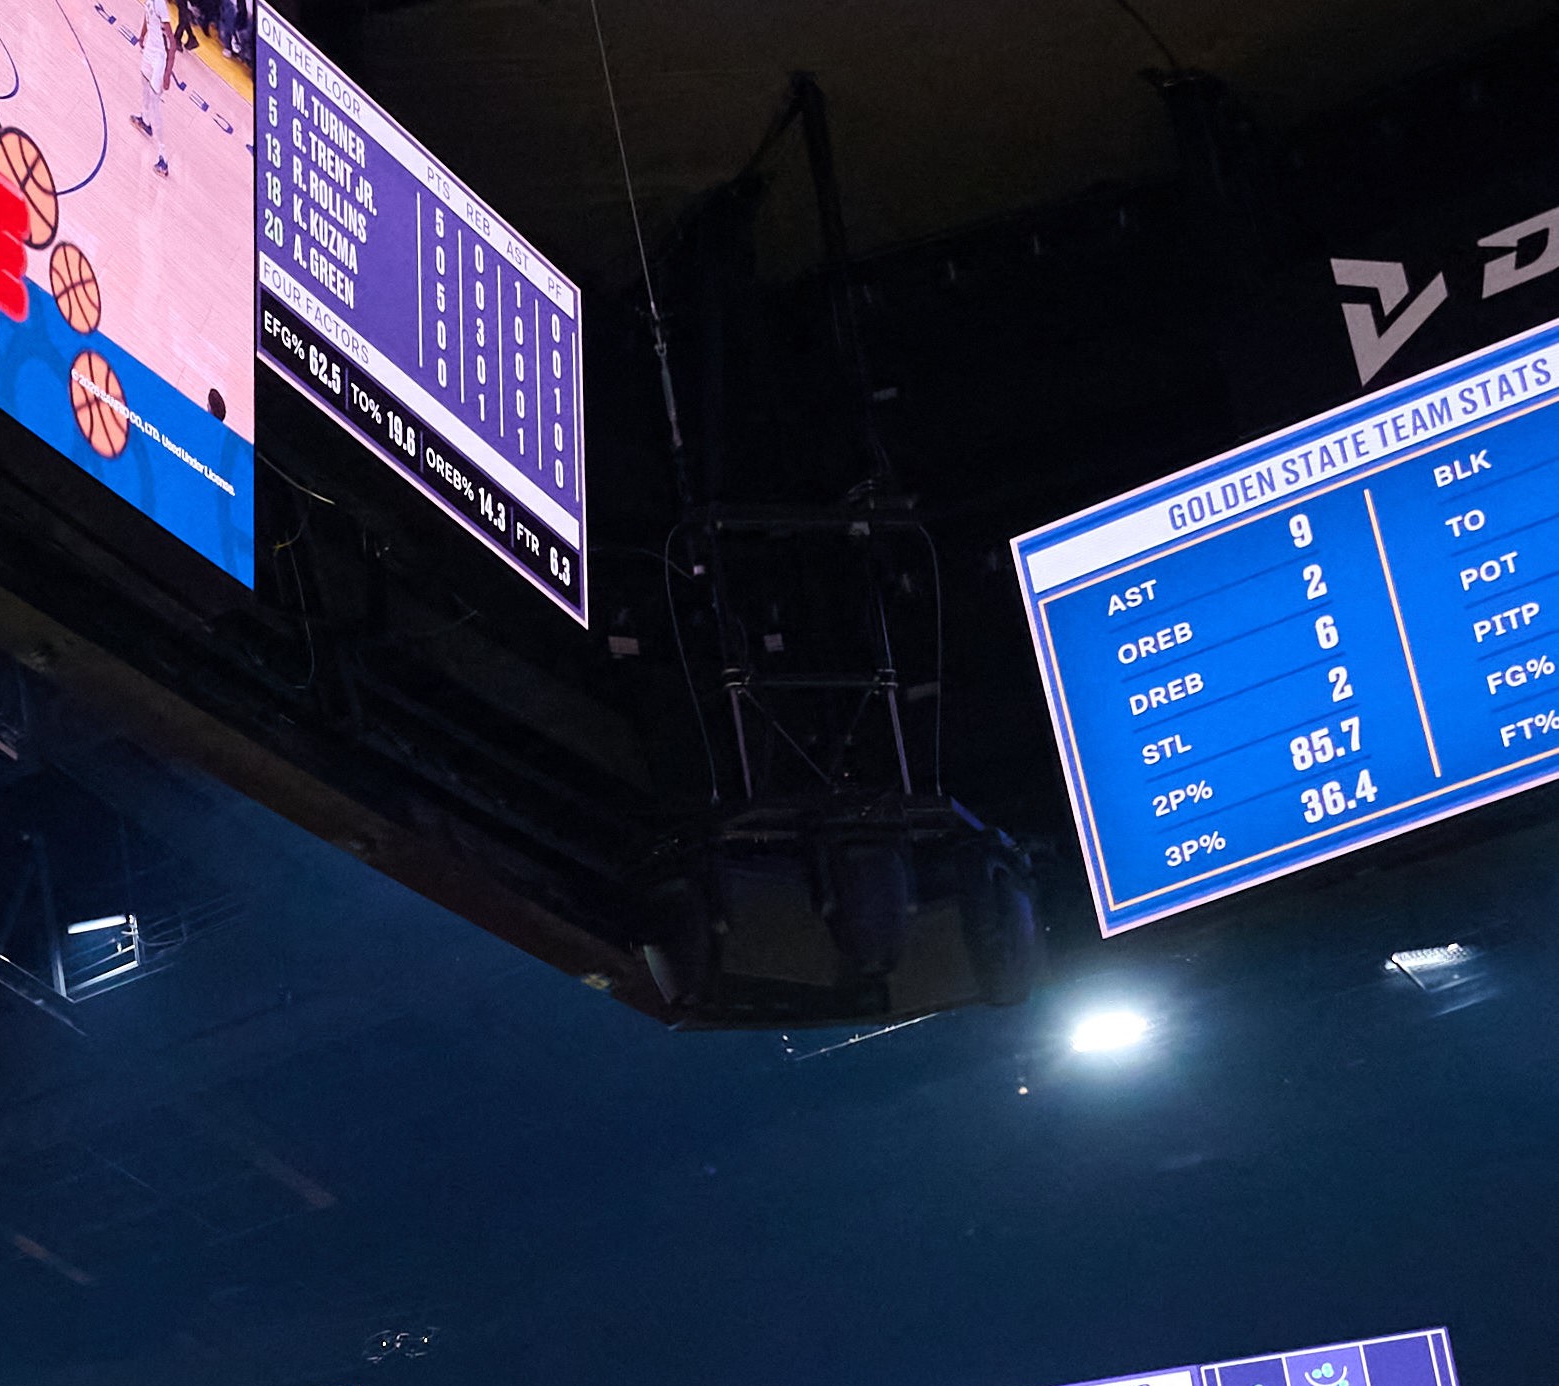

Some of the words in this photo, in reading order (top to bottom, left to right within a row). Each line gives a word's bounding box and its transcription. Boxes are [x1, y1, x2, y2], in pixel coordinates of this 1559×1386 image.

[261, 17, 282, 47] ON
[285, 36, 311, 75] THE
[316, 63, 361, 117] FLOOR
[426, 165, 450, 200] PTS
[466, 203, 491, 237] REB
[506, 240, 529, 272] AST
[547, 276, 562, 299] PF
[268, 58, 278, 89] 3
[291, 79, 309, 118] M.
[311, 95, 366, 169] TURNER
[435, 208, 444, 238] 5
[475, 244, 484, 274] 0
[514, 281, 522, 309] 1
[551, 313, 560, 343] 0
[268, 96, 278, 128] 5
[291, 118, 307, 153] G.
[309, 131, 353, 193] TRENT
[355, 177, 378, 216] JR.
[436, 246, 445, 276] 0
[475, 281, 485, 311] 0
[515, 316, 524, 346] 0
[552, 350, 561, 380] 0
[264, 261, 301, 305] FOUR
[305, 295, 369, 365] FACTORS
[264, 208, 284, 248] 20
[293, 234, 307, 270] A.
[309, 248, 354, 309] GREEN
[437, 358, 447, 388] 0
[478, 393, 485, 422] 1
[517, 427, 525, 456] 1
[555, 459, 564, 489] 0
[265, 133, 281, 168] 13
[292, 155, 307, 192] R.
[309, 170, 367, 244] ROLLINS
[436, 283, 446, 313] 5
[476, 318, 485, 348] 3
[515, 352, 524, 382] 0
[554, 388, 562, 415] 1
[266, 171, 282, 207] 18
[293, 194, 307, 232] K.
[310, 207, 358, 275] KUZMA
[437, 320, 446, 350] 0
[477, 355, 486, 385] 0
[516, 389, 525, 419] 0
[554, 423, 563, 452] 0
[264, 309, 305, 360] EFG%
[309, 344, 342, 395] 62.5
[351, 381, 382, 425] TO%
[387, 410, 416, 458] 19.6
[426, 447, 475, 502] OREB%
[478, 487, 506, 533] 14.3
[516, 521, 540, 556] FTR
[549, 546, 571, 587] 6.3
[1168, 467, 1276, 531] GOLDEN
[1281, 429, 1370, 486] STATE
[1374, 396, 1454, 449] TEAM
[1458, 357, 1552, 416] STATS
[1107, 579, 1157, 616] AST
[1289, 513, 1313, 548] 9
[1433, 449, 1492, 487] BLK
[1117, 622, 1193, 665] OREB
[1303, 564, 1328, 600] 2
[1445, 509, 1485, 537] TO
[1129, 672, 1204, 716] DREB
[1314, 615, 1340, 650] 6
[1459, 551, 1519, 591] POT
[1141, 734, 1192, 765] STL
[1328, 666, 1354, 703] 2
[1473, 602, 1540, 643] PITP
[1152, 780, 1213, 817] 2P%
[1289, 716, 1362, 772] 85.7
[1486, 655, 1556, 695] FG%
[1164, 831, 1226, 867] 3P%
[1300, 769, 1379, 824] 36.4
[1499, 710, 1559, 748] FT%
